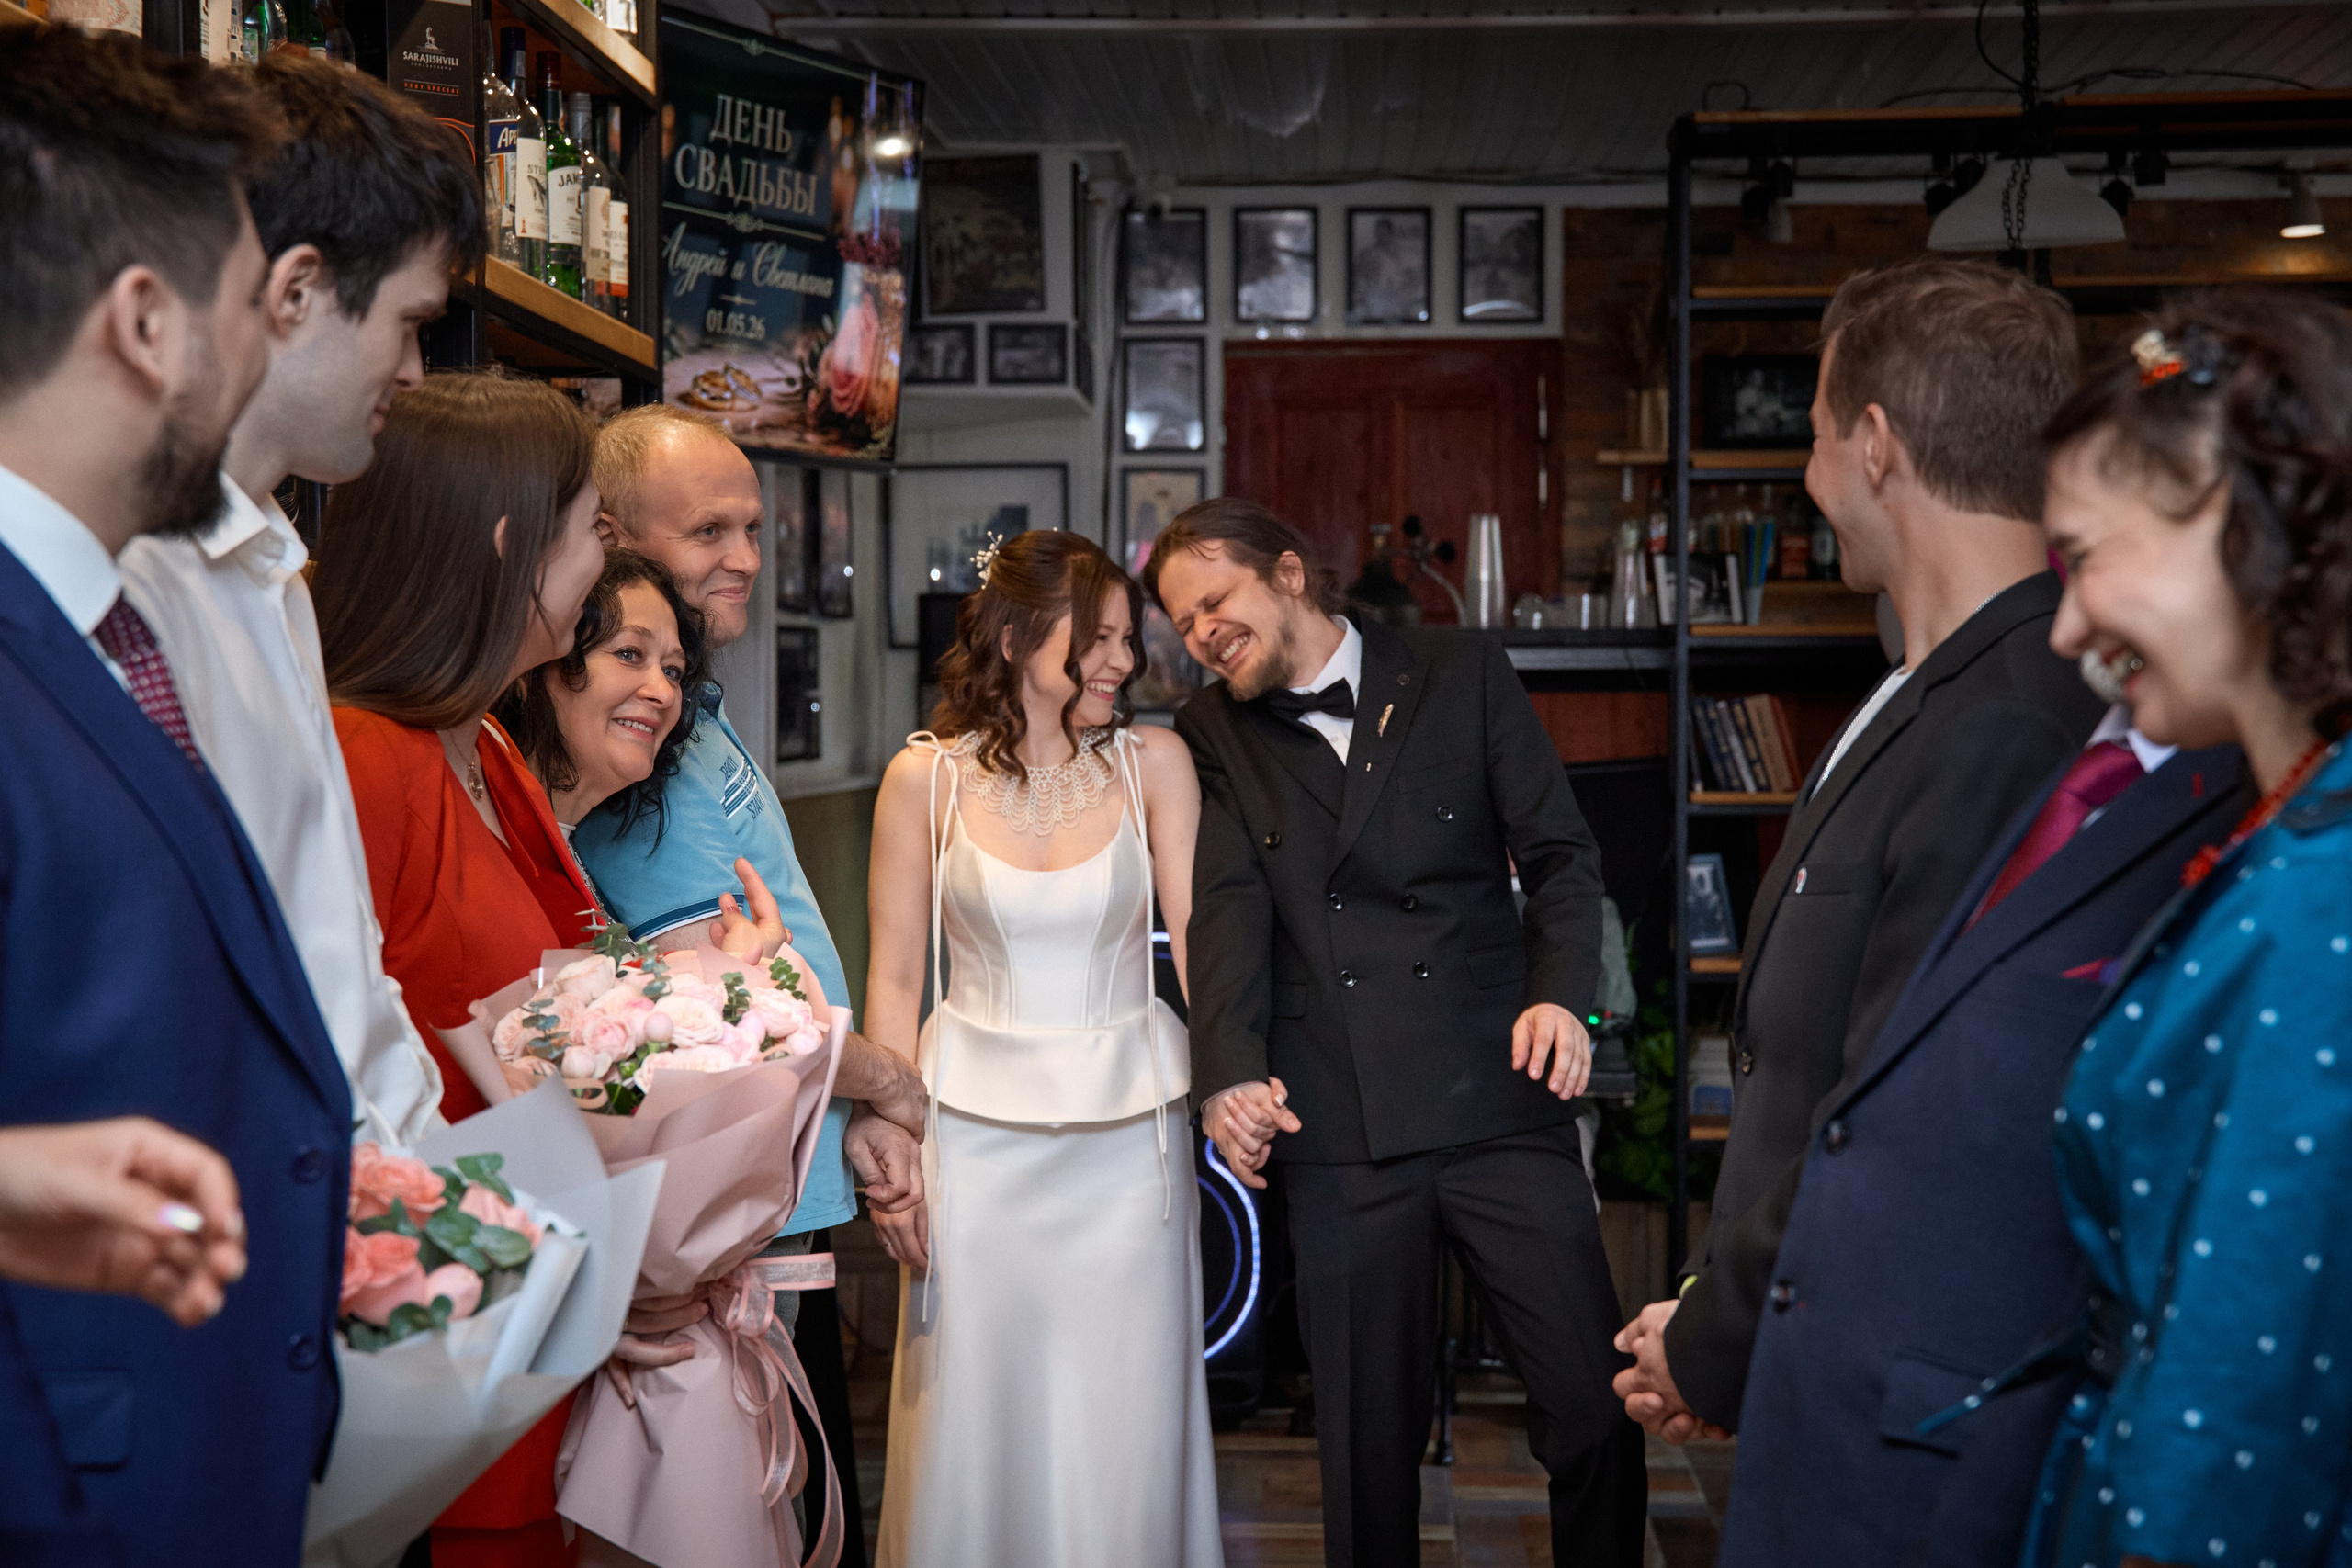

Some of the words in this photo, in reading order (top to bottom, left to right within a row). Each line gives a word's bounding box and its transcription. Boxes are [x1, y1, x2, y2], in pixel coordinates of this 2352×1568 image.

[402, 51, 459, 67] SARAJISHVILI
[404, 82, 424, 90] VERY
[426, 84, 459, 95] SPECIAL
[708, 93, 793, 154] ДЕНЬ
[674, 142, 818, 217] СВАДЬБЫ
[662, 221, 729, 298] Андрей
[731, 260, 746, 280] и
[705, 308, 766, 341] 01.05.26
[745, 791, 766, 820] START
